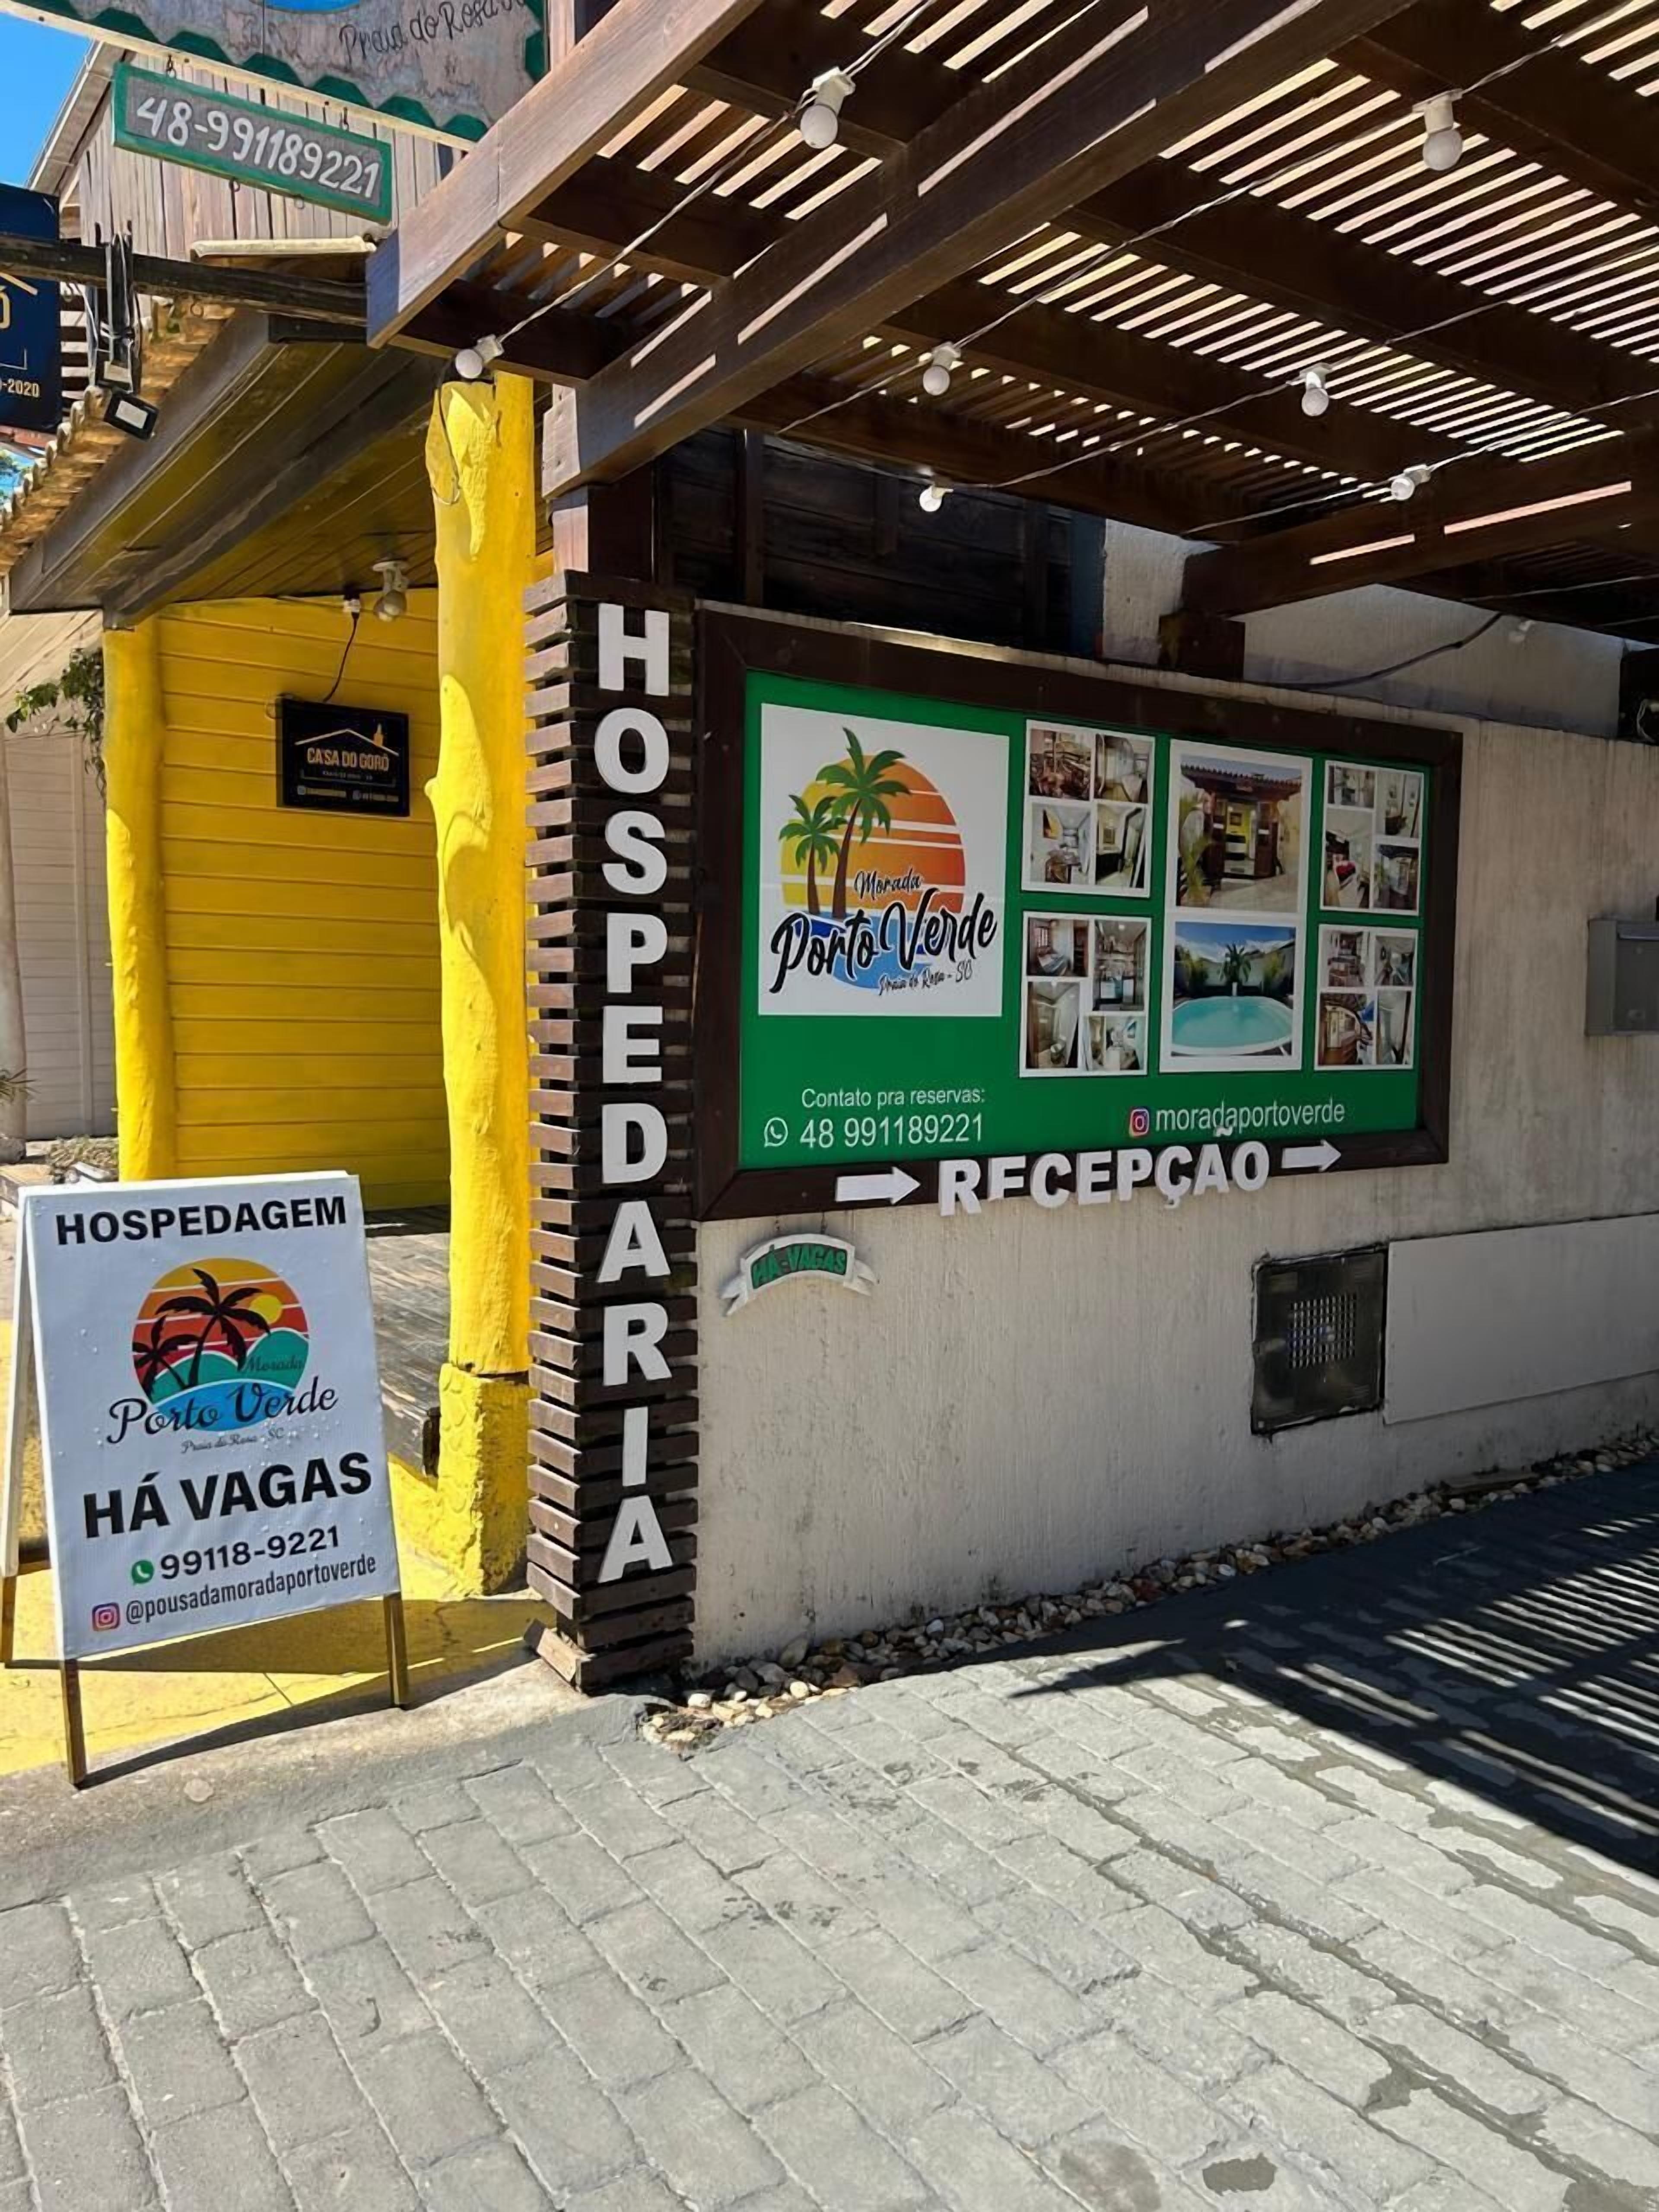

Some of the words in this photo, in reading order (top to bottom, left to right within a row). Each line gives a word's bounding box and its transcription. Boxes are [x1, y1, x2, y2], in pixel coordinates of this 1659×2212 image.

[339, 22, 408, 67] Praia
[410, 10, 439, 43] do
[137, 96, 379, 198] 48-991189221
[0, 378, 40, 397] -2020
[307, 747, 340, 766] CASA
[341, 750, 357, 768] DO
[854, 866, 923, 901] Morada
[769, 909, 879, 994] Porto
[879, 887, 997, 973] Verde
[594, 603, 673, 1583] HOSPEDARIA
[801, 1087, 871, 1109] Contato
[877, 1091, 905, 1110] pra
[910, 1087, 985, 1106] reservas:
[1156, 1096, 1345, 1134] moradaportoverde
[800, 1118, 834, 1149] 48
[844, 1112, 983, 1148] 991189221
[56, 1196, 346, 1246] HOSPEDAGEM
[106, 1397, 219, 1444] Porto
[225, 1376, 339, 1427] Verde
[83, 1471, 171, 1538] HÁ
[179, 1452, 372, 1522] VAGAS
[160, 1525, 340, 1580] 99118-9221
[126, 1554, 377, 1626] @pousadamoradaportoverde
